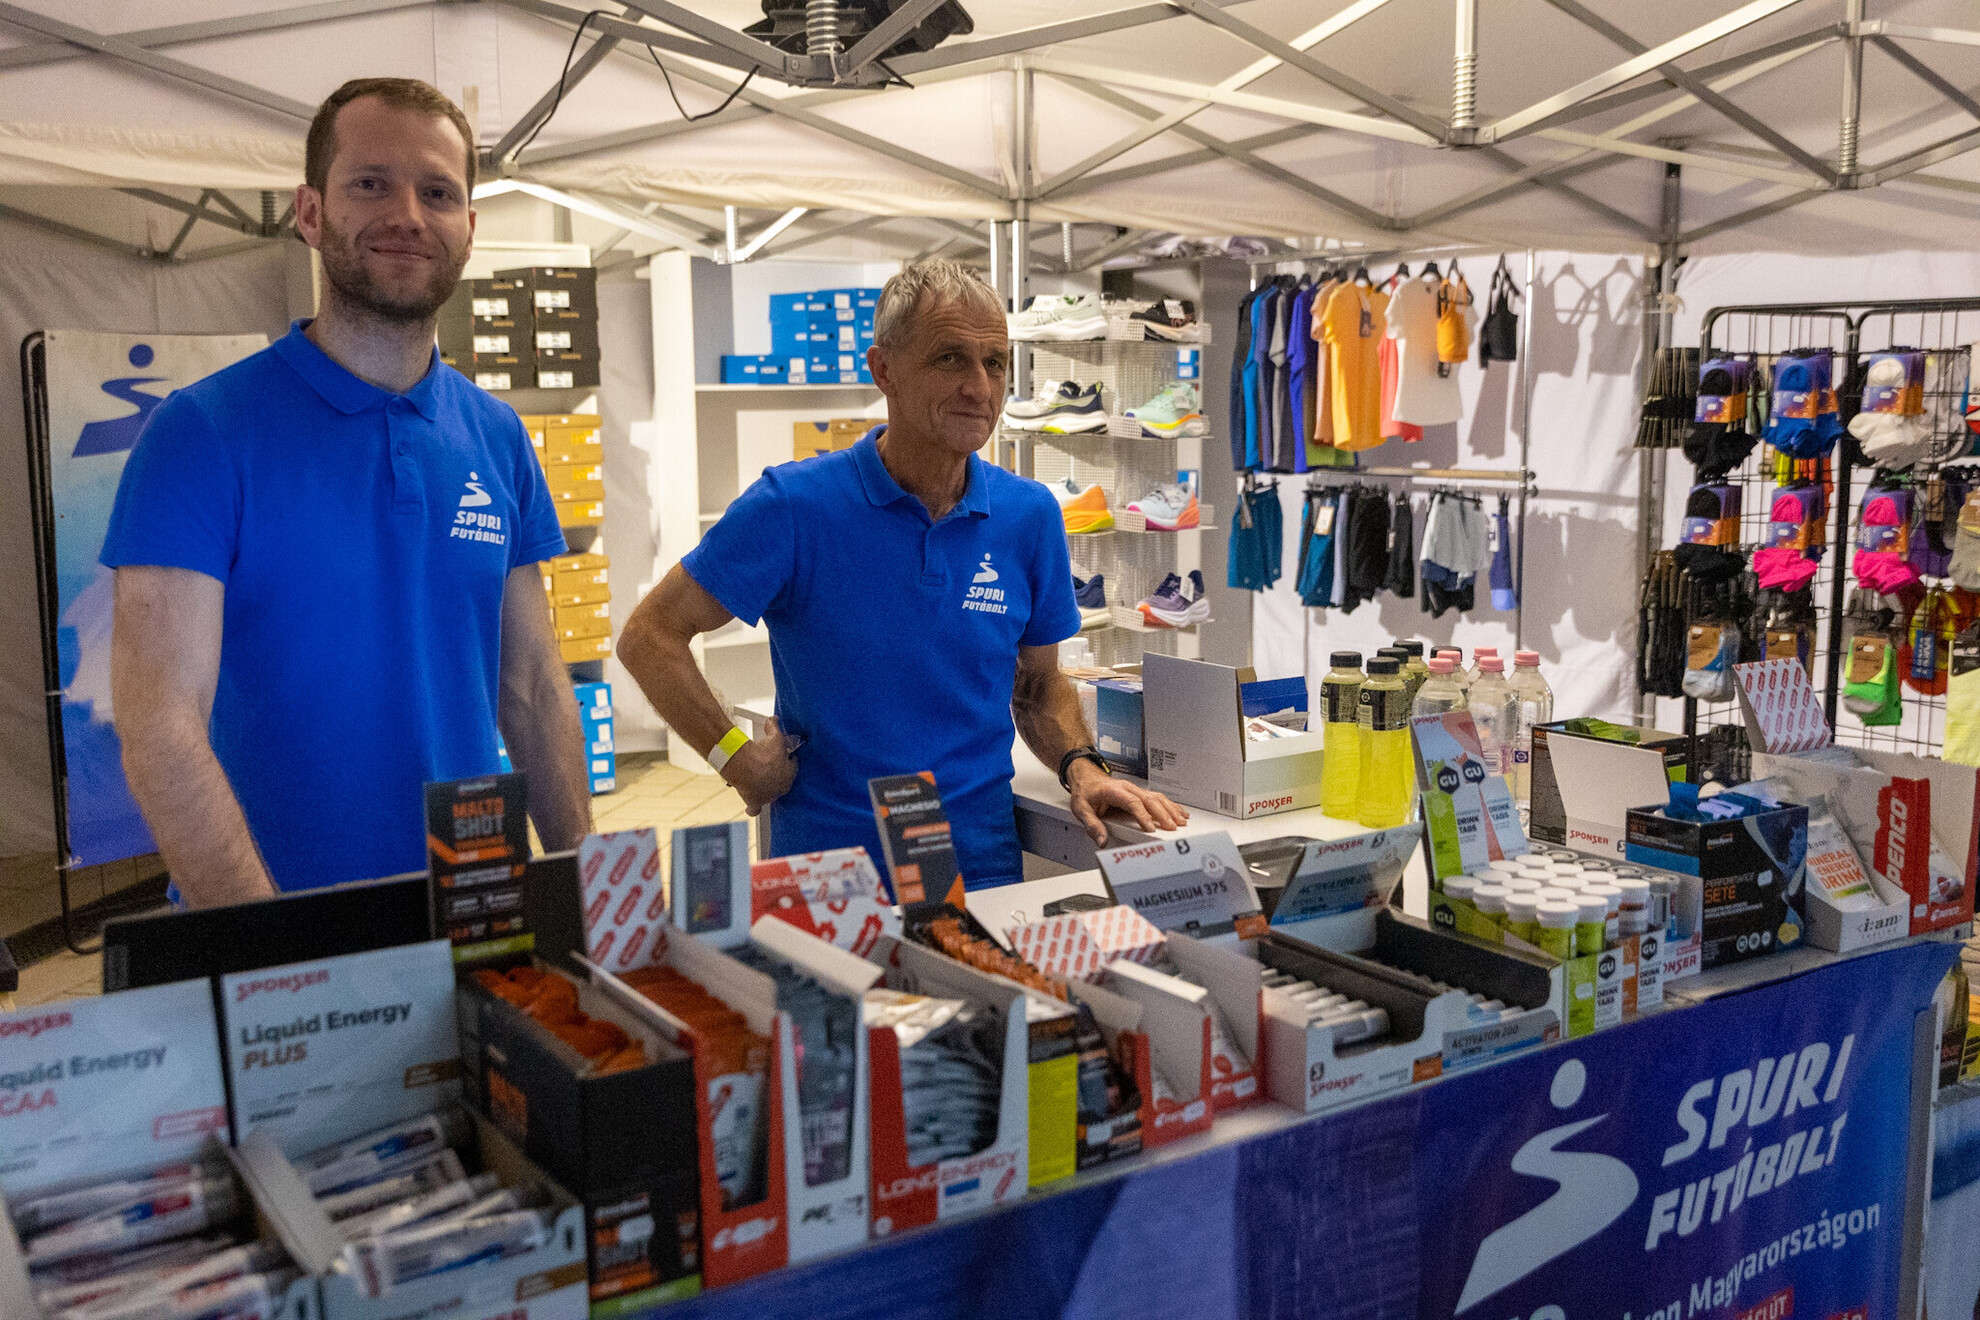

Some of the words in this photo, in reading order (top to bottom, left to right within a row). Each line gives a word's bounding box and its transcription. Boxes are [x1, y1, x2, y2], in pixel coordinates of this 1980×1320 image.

[453, 510, 501, 530] SPURI
[449, 526, 505, 545] FUTÓBOLT
[966, 585, 1004, 602] SPURI
[961, 600, 1008, 615] FUTÓBOLT
[1413, 715, 1440, 726] SPONSER
[1465, 765, 1482, 778] GU
[1439, 775, 1458, 788] GU
[1248, 795, 1293, 815] SPONSER
[1488, 803, 1511, 814] DRINK
[1457, 815, 1480, 826] DRINK
[1491, 812, 1510, 821] TABS
[1459, 823, 1477, 834] TABS
[1570, 830, 1609, 845] SPONSER
[1113, 844, 1165, 864] SPONSER
[1316, 838, 1364, 856] SPONSER
[1815, 857, 1858, 876] ENERGY
[1820, 867, 1866, 890] DRINK
[1133, 885, 1203, 908] MAGNESIUM
[1203, 880, 1228, 896] 375
[1434, 910, 1454, 925] GU
[1642, 943, 1656, 956] GU
[1599, 961, 1615, 975] GU
[1640, 967, 1660, 978] DRINK
[236, 968, 330, 1003] SPONSER
[1597, 986, 1618, 997] DRINK
[240, 1012, 321, 1046] Liquid
[326, 1001, 412, 1032] Energy
[1451, 1029, 1500, 1048] ACTIVATOR
[69, 1044, 168, 1078] Energy
[244, 1040, 309, 1071] PLUS
[1661, 1033, 1856, 1168] SPURI
[1644, 1111, 1849, 1252] FUTÓBOLT
[1688, 1203, 1881, 1319] Magyarországon
